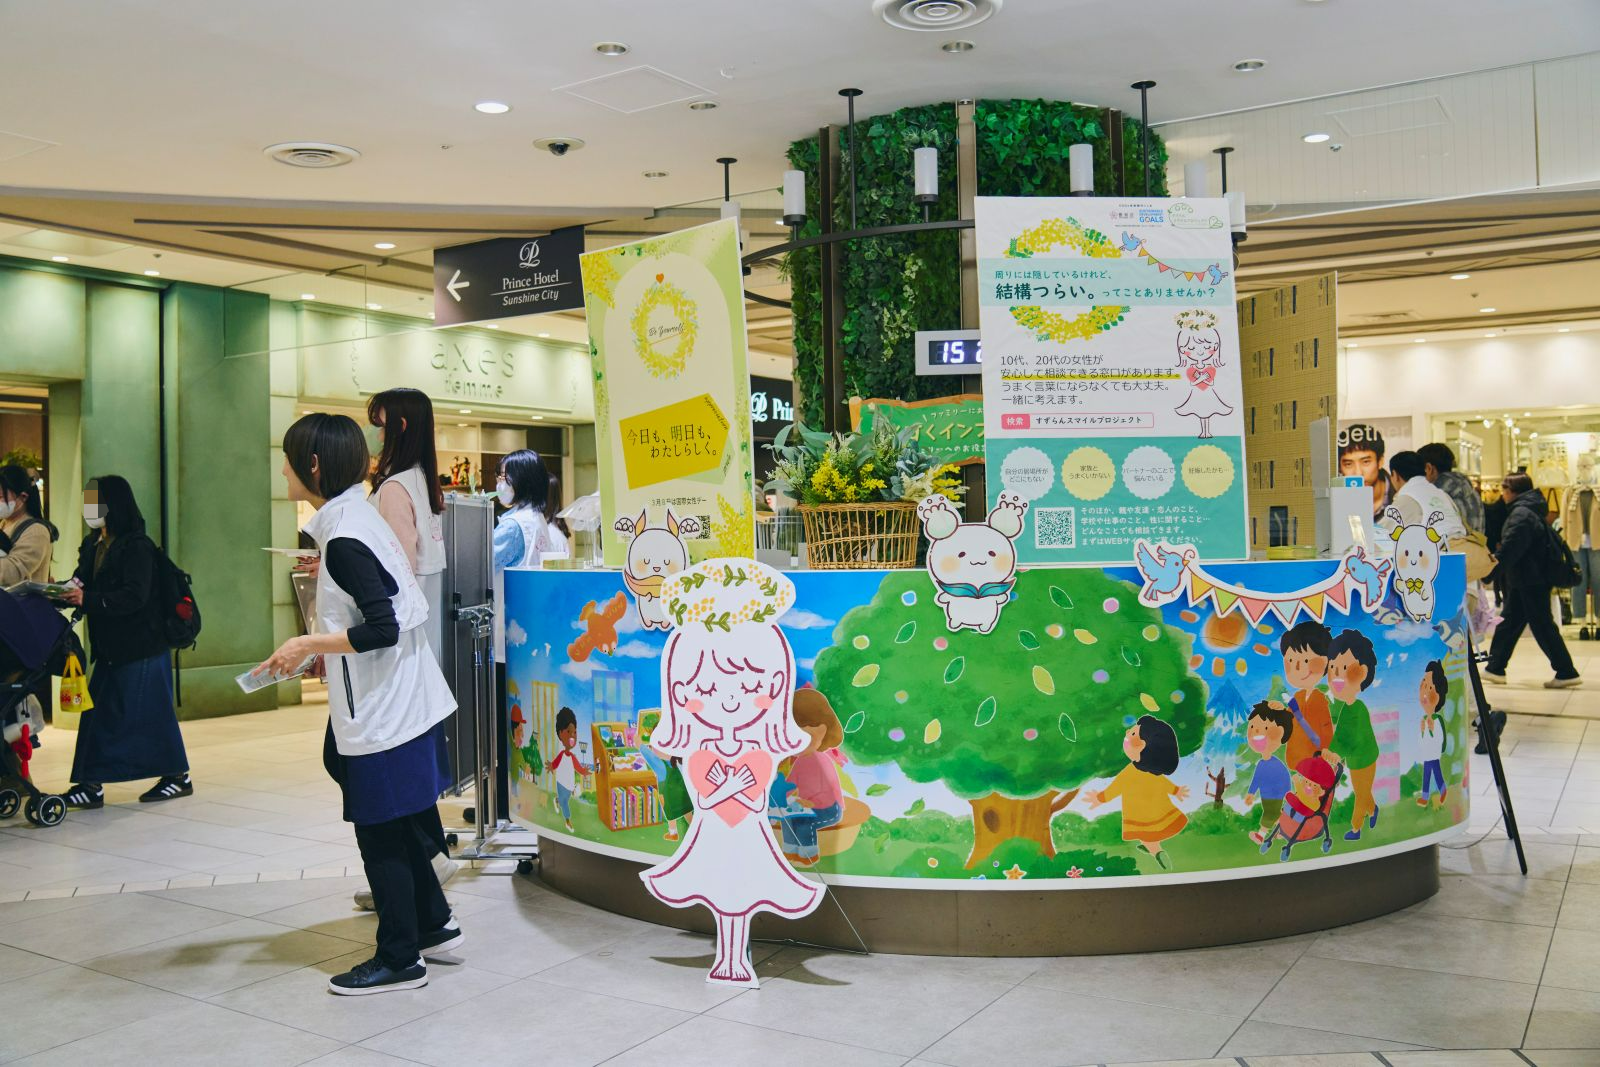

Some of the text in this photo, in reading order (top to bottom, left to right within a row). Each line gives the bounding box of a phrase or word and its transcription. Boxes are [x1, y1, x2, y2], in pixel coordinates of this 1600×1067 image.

[502, 268, 559, 290] Prince Hotel
[995, 270, 1112, 279] 周りには隠しているけれど、
[502, 288, 560, 306] Sunshine City
[995, 282, 1095, 300] 結構つらい。
[431, 343, 515, 378] axes
[942, 341, 965, 363] 15
[1000, 354, 1104, 366] 10代、20代の女性が
[1000, 367, 1180, 379] 安心して相談できる窓口があります。
[1001, 381, 1169, 392] うまく言葉にならなくても大丈夫。
[1001, 394, 1083, 405] 一緒に考えます。
[1006, 415, 1142, 426] 検索 すずらんスマイルプロジェクト
[626, 424, 711, 446] 今日も、明日も、
[650, 441, 717, 458] わたしらしく。
